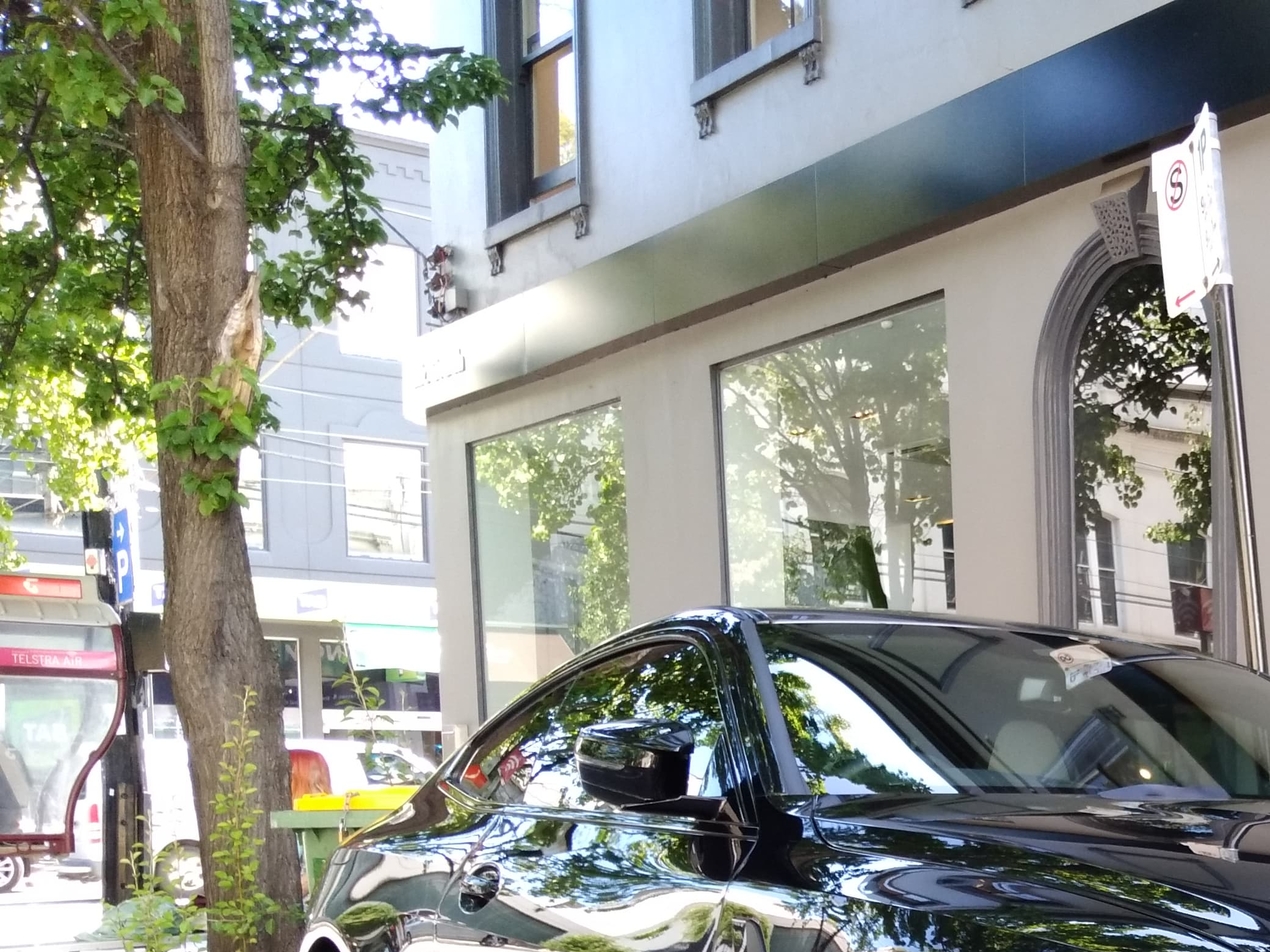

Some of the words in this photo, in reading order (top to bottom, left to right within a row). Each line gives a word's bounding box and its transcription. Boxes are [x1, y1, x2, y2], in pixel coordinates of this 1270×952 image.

[1171, 168, 1184, 204] S
[116, 549, 129, 594] P
[11, 653, 60, 666] TELSTRA
